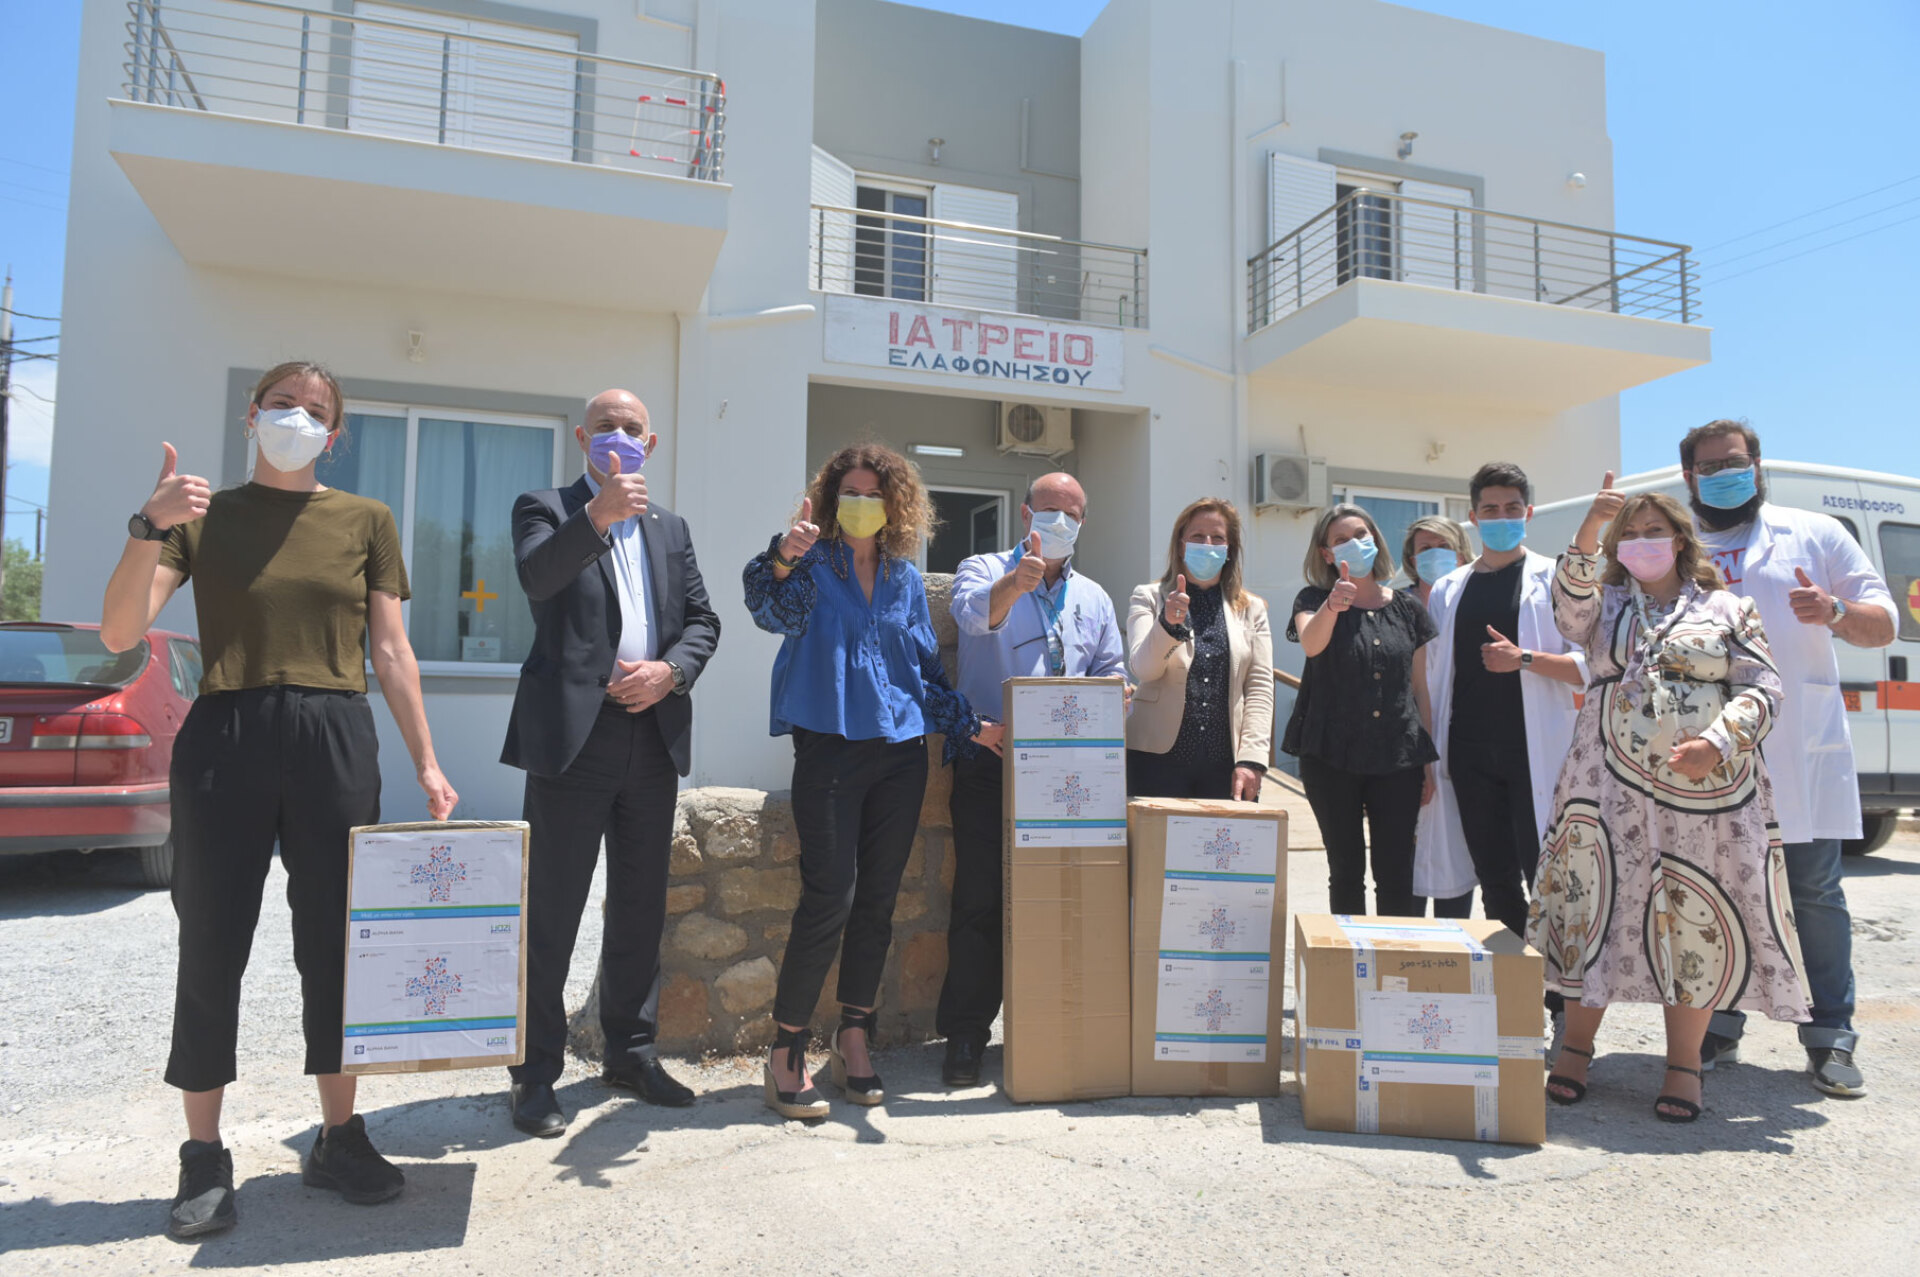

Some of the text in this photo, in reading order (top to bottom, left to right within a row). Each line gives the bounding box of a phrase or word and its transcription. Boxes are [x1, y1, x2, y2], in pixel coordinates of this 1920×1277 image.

[889, 311, 1094, 367] ΙΑΤΡΕΙΟ
[888, 348, 1093, 387] ΕΛΑΦΟΝΗΣΟΥ
[1822, 494, 1905, 515] ΑΣΘΕΝΟΦΟΡΟ
